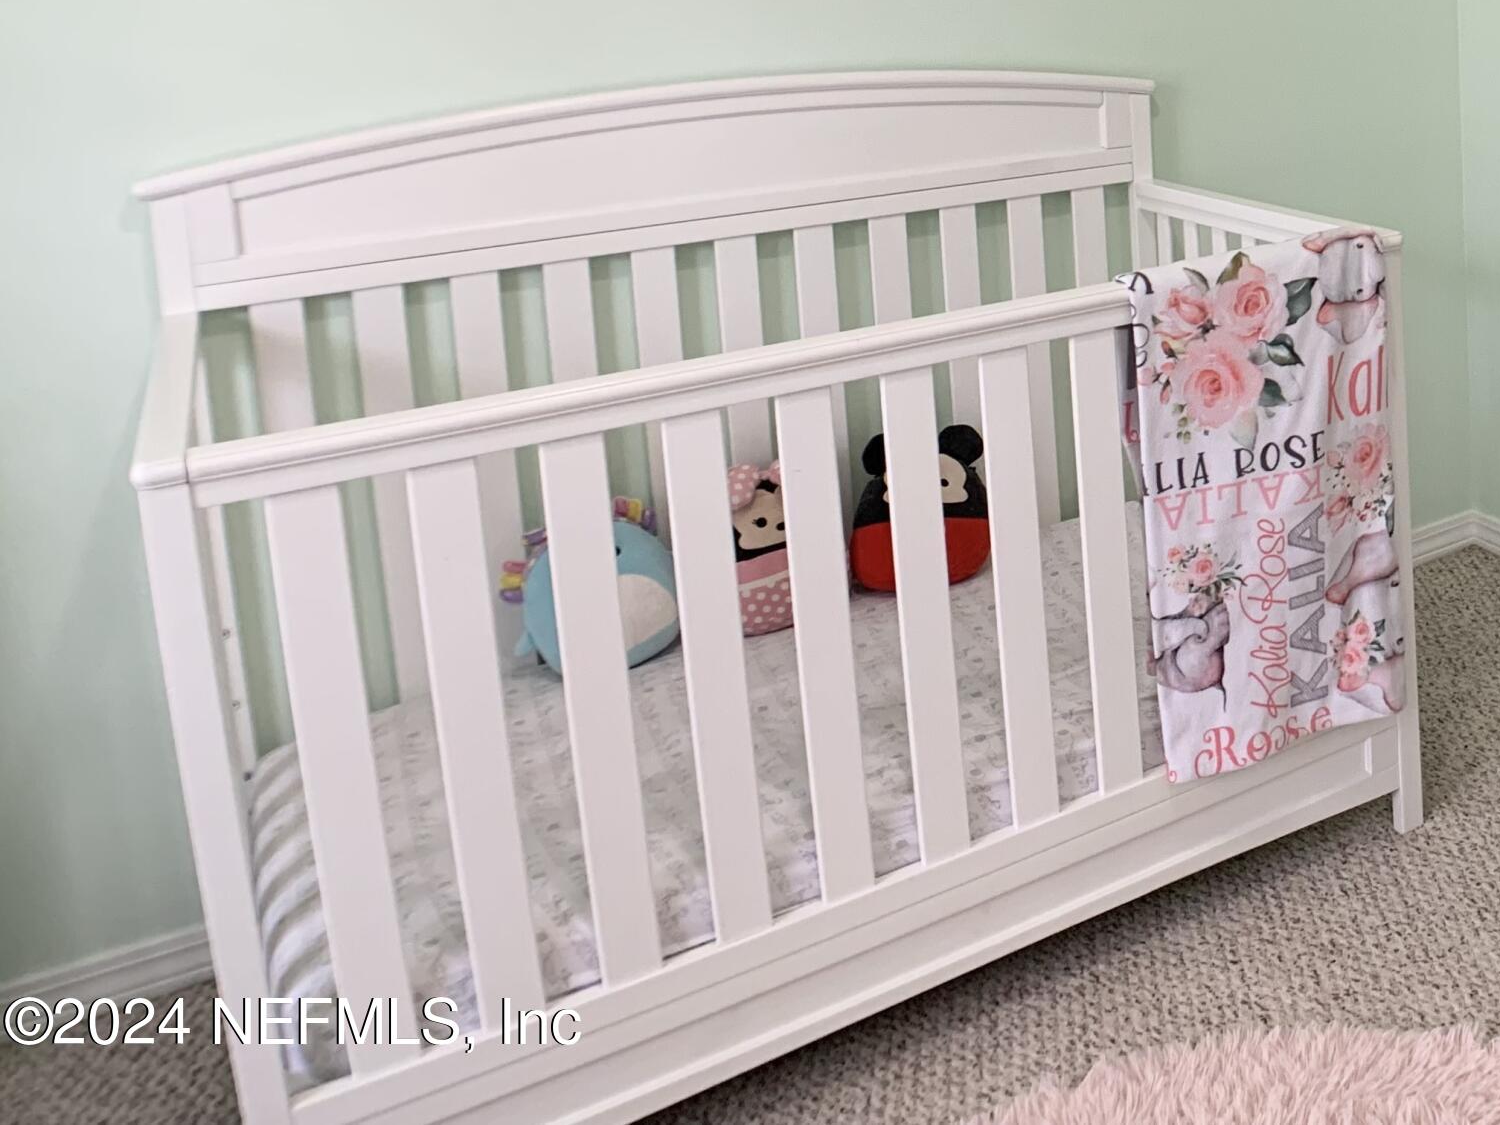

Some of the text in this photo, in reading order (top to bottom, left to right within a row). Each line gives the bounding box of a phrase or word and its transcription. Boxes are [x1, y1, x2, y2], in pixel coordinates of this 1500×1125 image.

[1327, 345, 1389, 425] Kal
[1234, 429, 1326, 479] ROSE
[1152, 464, 1325, 531] KALIA
[1239, 518, 1292, 718] Kalia Rose
[1287, 502, 1329, 708] KALIA
[1195, 706, 1333, 779] Rose
